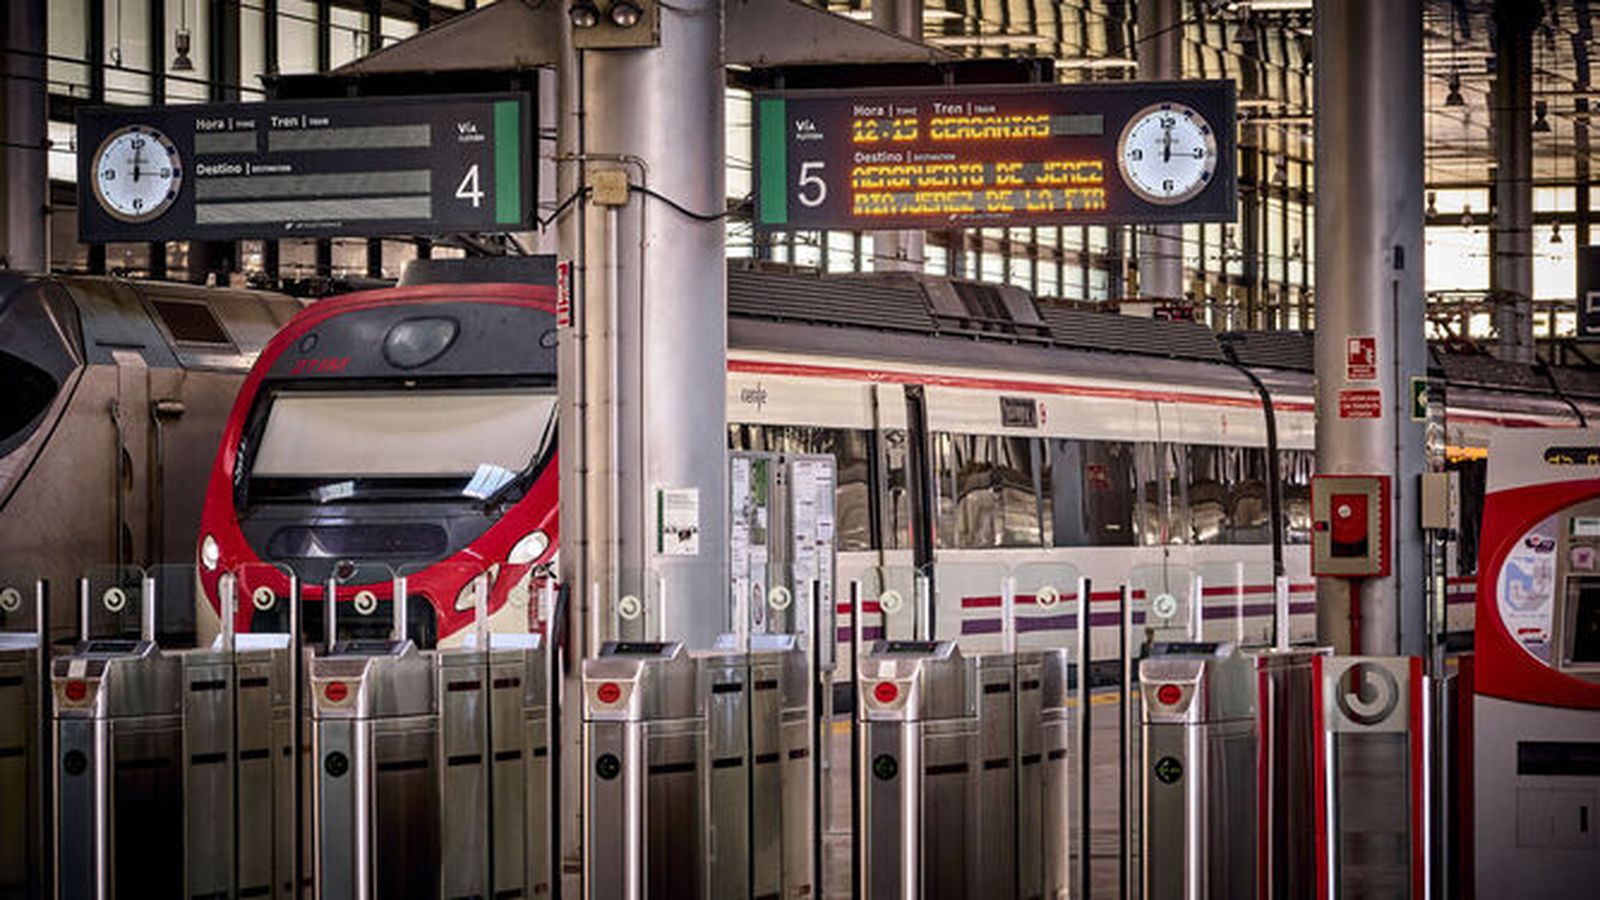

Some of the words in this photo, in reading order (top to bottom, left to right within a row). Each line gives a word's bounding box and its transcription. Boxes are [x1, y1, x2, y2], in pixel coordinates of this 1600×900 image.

[853, 104, 885, 117] Hora
[932, 102, 964, 115] Tren
[195, 118, 226, 131] Hora
[270, 115, 299, 128] Tren
[930, 115, 1051, 139] CERCANIAS
[854, 151, 903, 164] Destino
[195, 163, 244, 176] Destino
[852, 164, 985, 188] AEROPUERTO
[995, 162, 1023, 185] DE
[1035, 160, 1104, 184] JEREZ
[455, 164, 485, 207] 4
[798, 161, 828, 208] 5
[985, 189, 1015, 212] DE
[1025, 189, 1054, 212] LA
